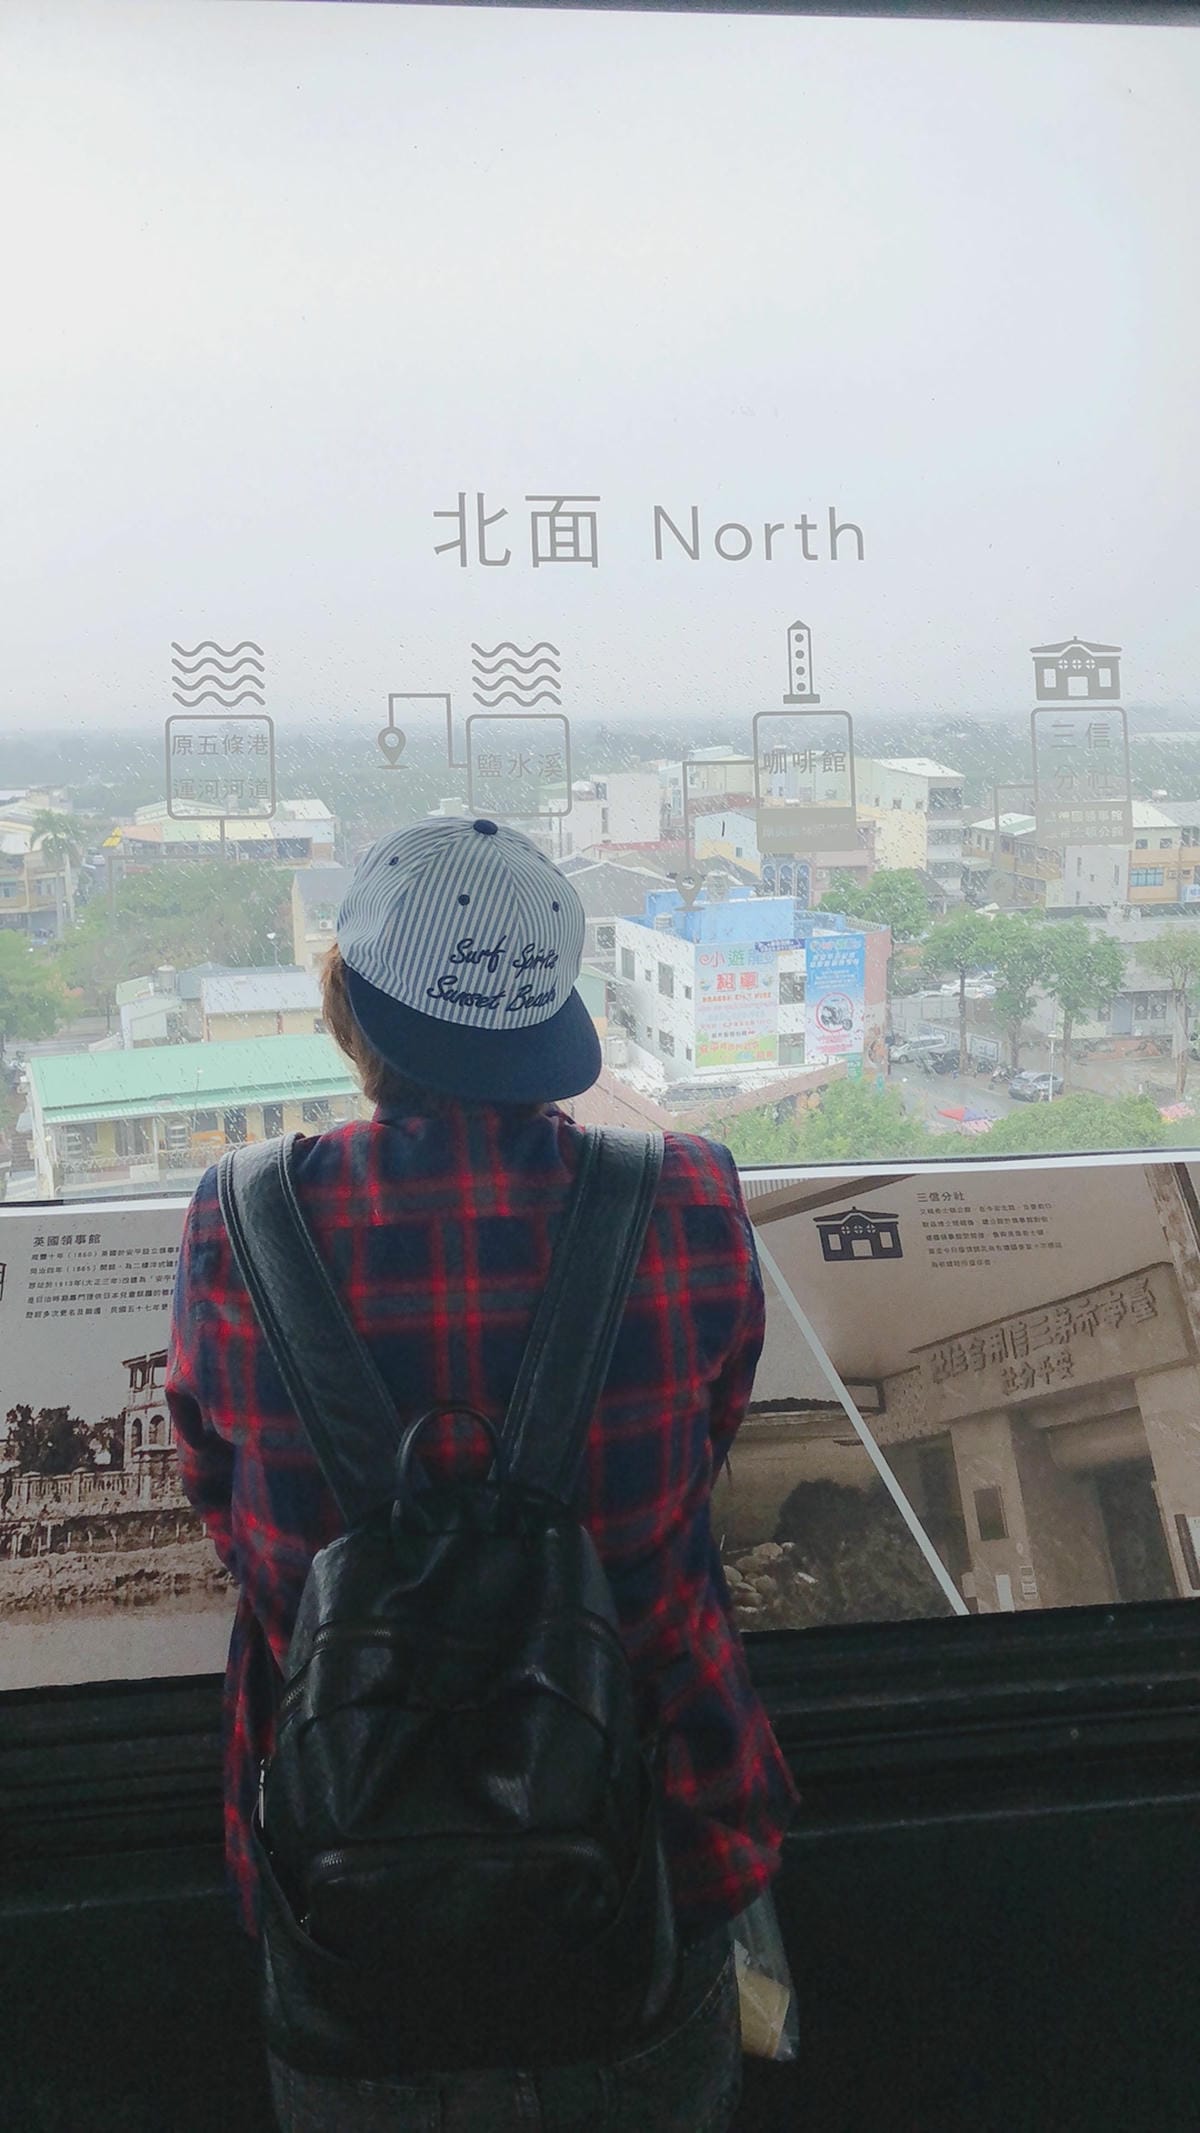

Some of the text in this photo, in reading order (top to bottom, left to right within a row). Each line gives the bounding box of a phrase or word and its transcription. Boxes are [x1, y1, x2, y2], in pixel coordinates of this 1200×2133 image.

[433, 491, 600, 568] 北面
[653, 505, 866, 561] North
[172, 734, 269, 756] 原五條港
[1051, 722, 1111, 749] 三信
[477, 752, 563, 778] 鹽水溪
[763, 750, 848, 775] 咖啡館
[173, 778, 270, 800] 運河河道
[449, 935, 507, 973] Surf
[427, 975, 557, 1012] Sunset Beach
[916, 1191, 966, 1203] 三信分社
[33, 1234, 102, 1248] 英國領事館
